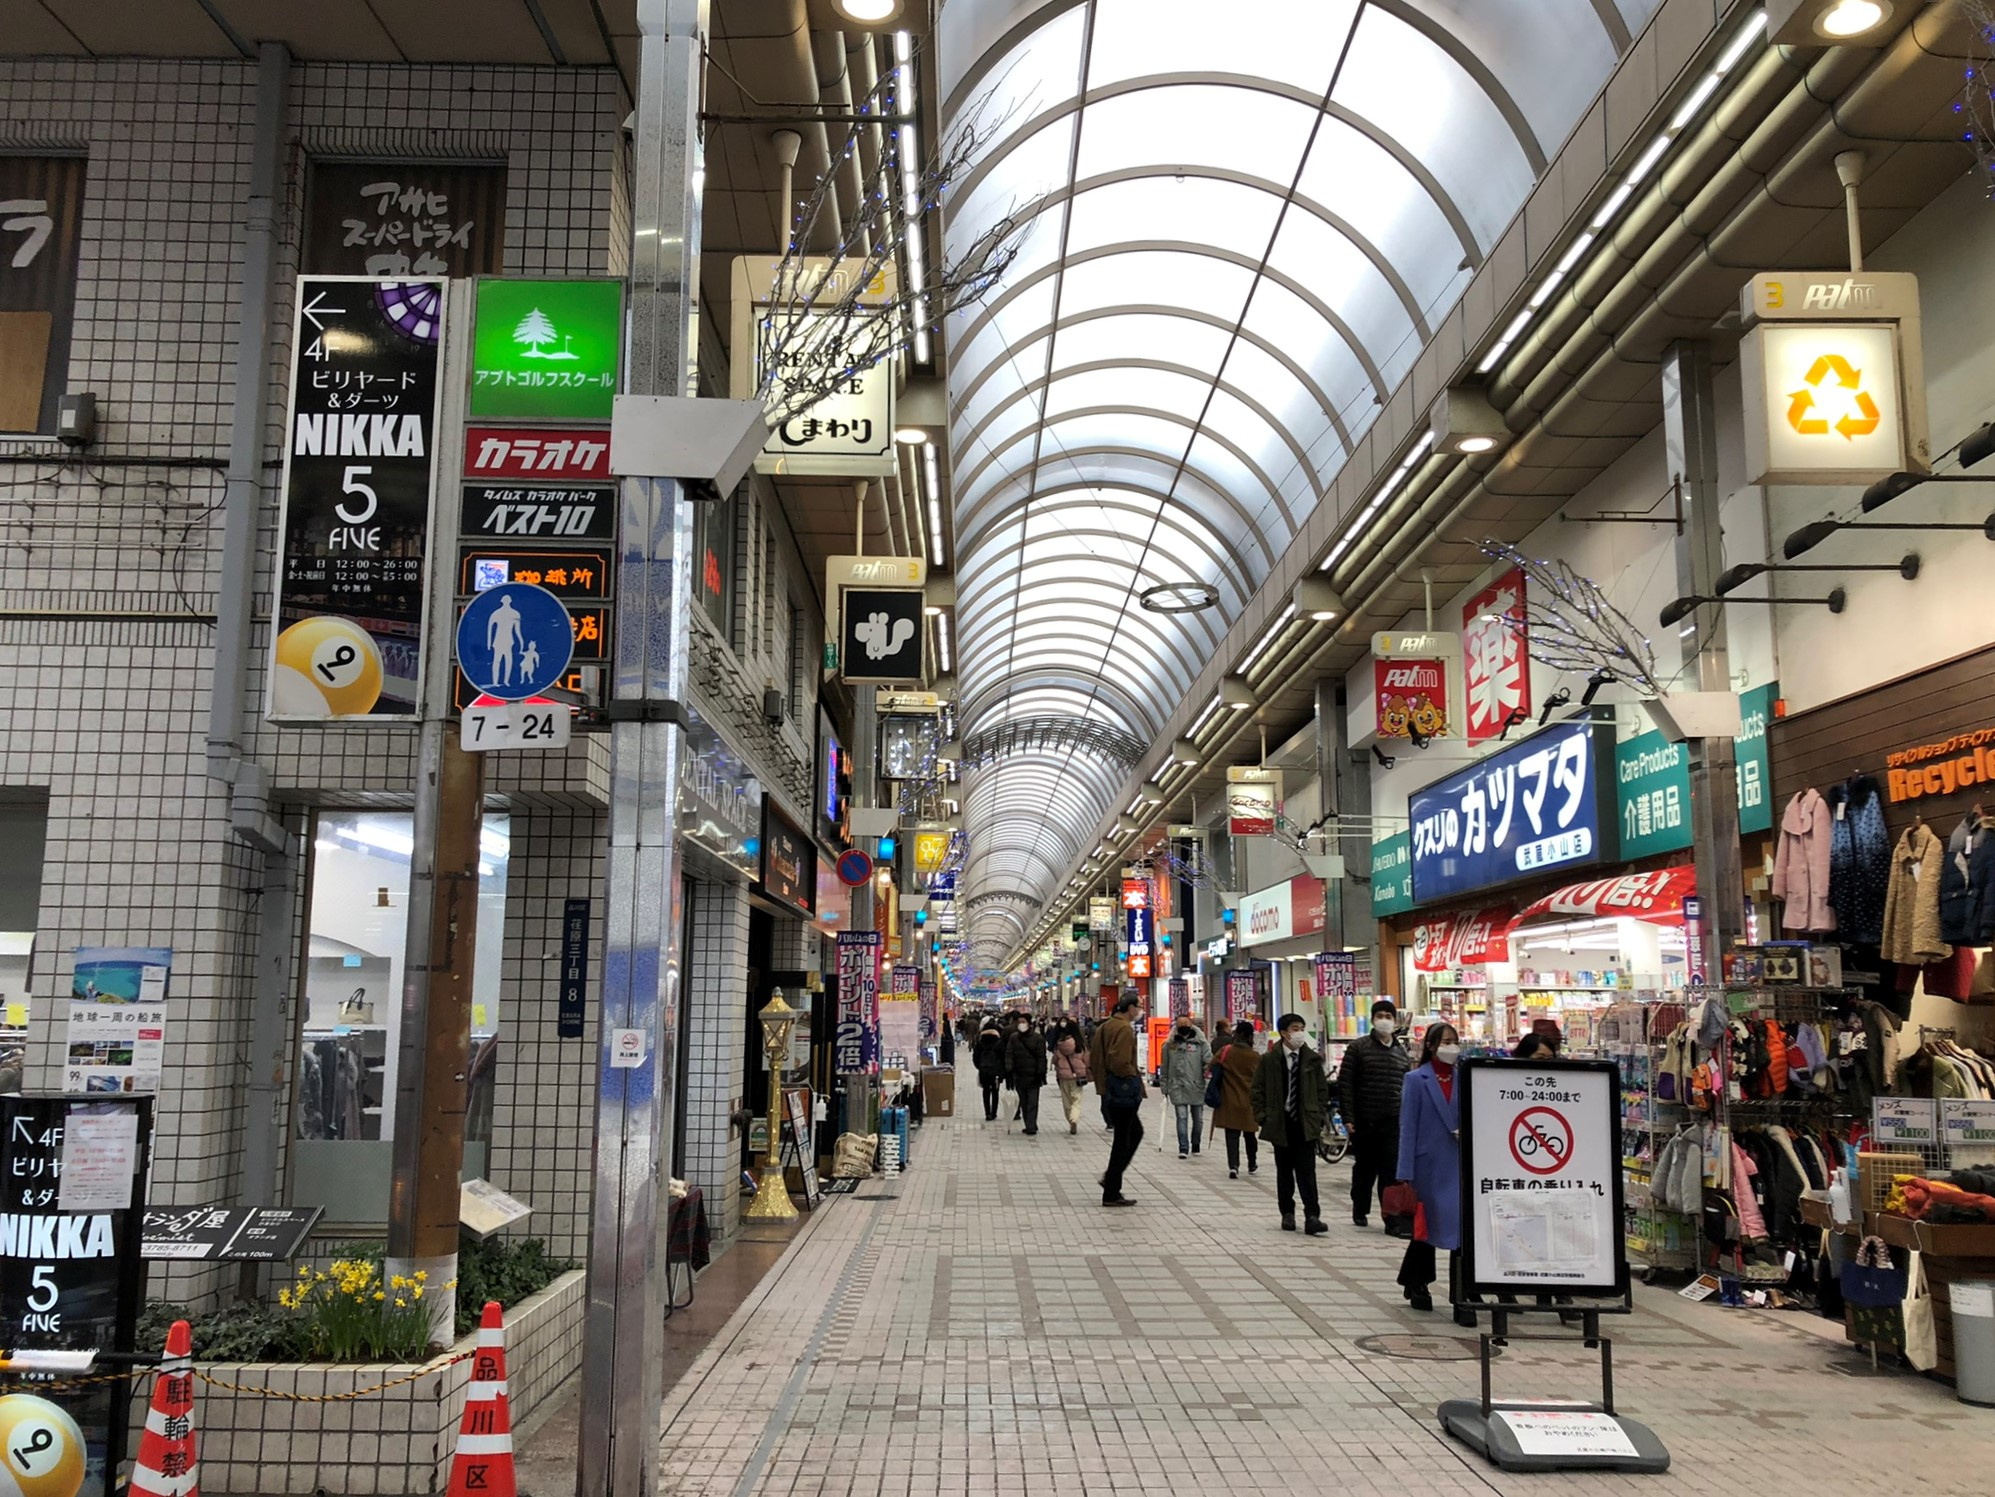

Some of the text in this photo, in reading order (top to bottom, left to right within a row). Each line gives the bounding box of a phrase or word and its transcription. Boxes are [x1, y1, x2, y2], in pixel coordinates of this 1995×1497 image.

[360, 182, 448, 216] アサヒ
[341, 220, 474, 250] スーパードライ
[1765, 281, 1785, 309] 3
[303, 336, 341, 362] 4F
[312, 370, 416, 390] ビリヤード
[327, 392, 399, 410] &ダーツ
[295, 413, 424, 458] NIKKA
[474, 437, 607, 471] カラオケ
[334, 465, 378, 525] 5
[483, 489, 597, 503] タイムズ カラオケ パーク
[482, 504, 596, 535] ベスト10
[328, 526, 381, 551] FIVE
[907, 562, 919, 580] 3
[1467, 586, 1523, 731] 楽
[1620, 757, 1640, 783] Care
[1414, 733, 1588, 862] クスリの カツマタ
[1624, 785, 1681, 840] 介護用品
[1523, 833, 1583, 867] 武蔵小山店
[568, 988, 577, 1002] 8
[840, 948, 863, 1022] ポイント
[72, 1011, 163, 1023] 地球一周の船旅
[836, 1023, 864, 1066] 2倍
[1525, 1076, 1557, 1088] この先
[38, 1128, 63, 1147] 4F
[22, 1189, 60, 1206] &ダ
[0, 1213, 114, 1259] NIKKA
[27, 1266, 58, 1312] 5
[22, 1314, 61, 1333] FIVE
[465, 1356, 499, 1489] 品川区
[161, 1379, 191, 1497] 駐輪禁
